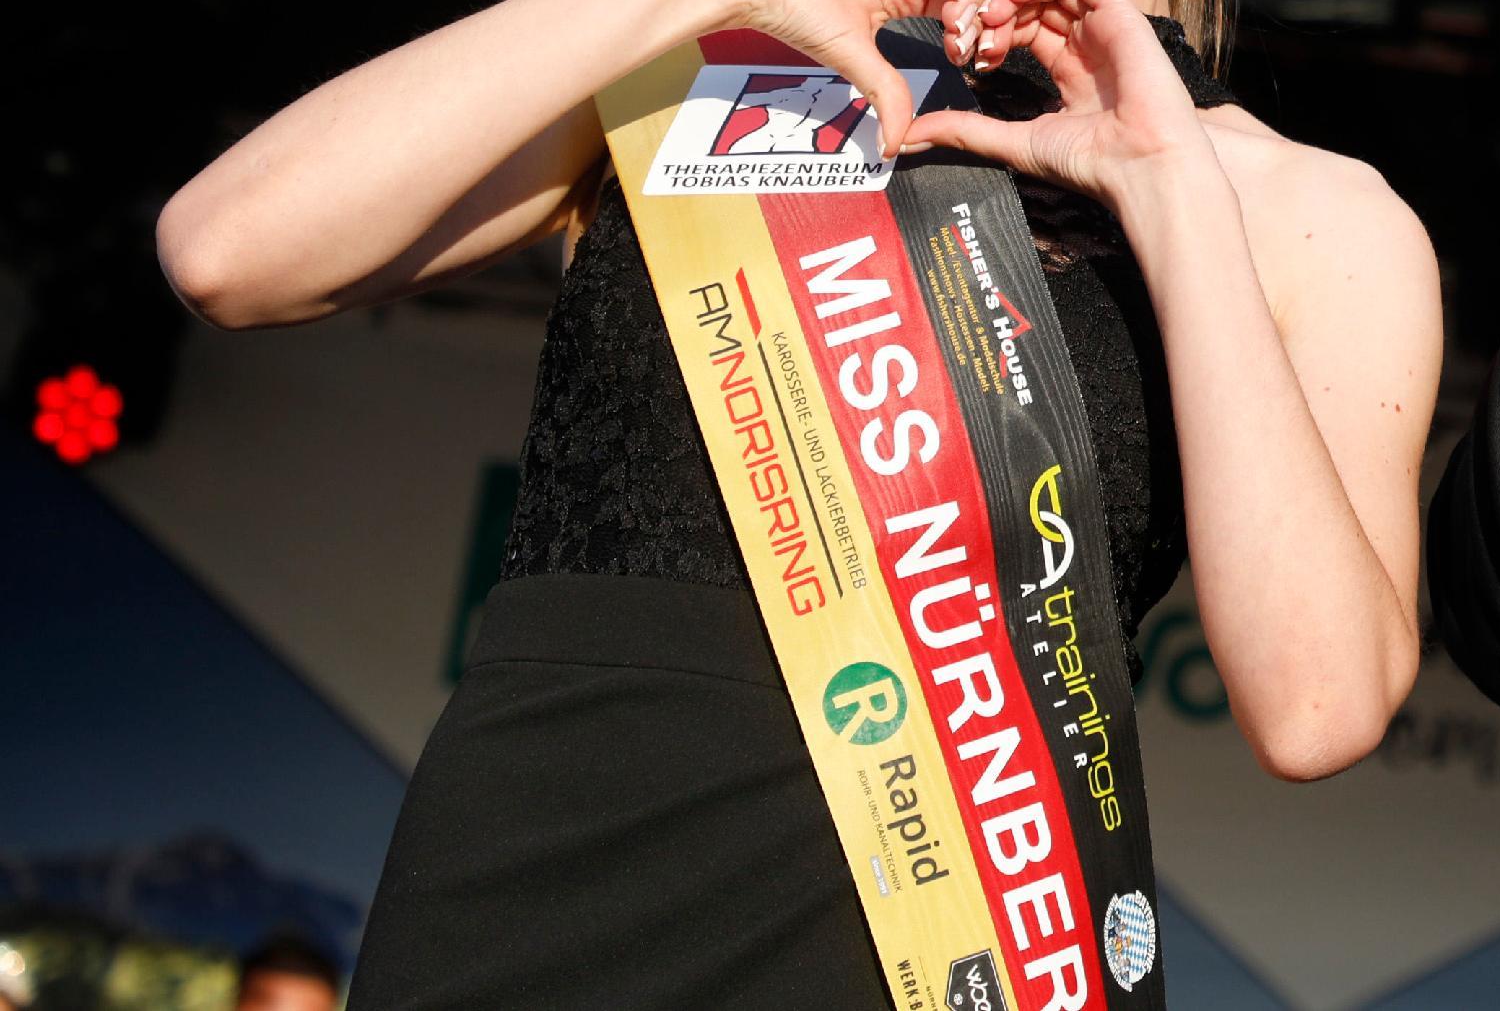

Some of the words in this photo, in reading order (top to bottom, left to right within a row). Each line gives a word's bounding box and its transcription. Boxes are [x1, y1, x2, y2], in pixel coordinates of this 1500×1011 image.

[663, 162, 883, 176] THERAPIEZENTRUM
[670, 176, 750, 188] TOBIAS
[758, 175, 866, 187] KNAUBER
[926, 268, 967, 367] www.fishershouse.de
[929, 236, 956, 300] Fashionshows
[972, 356, 990, 394] Models
[951, 202, 1000, 311] FISHER'S
[992, 315, 1034, 407] HOUSE
[979, 335, 1005, 395] Modelschule
[771, 331, 814, 427] KAROSSERIE-
[803, 428, 826, 463] UND
[815, 466, 867, 590] LACKIERBETRIEB
[798, 234, 940, 476] MISS
[885, 500, 1089, 1011] NÜRNBER
[1020, 583, 1090, 768] ATELIER
[1044, 586, 1123, 832] trainings
[868, 800, 881, 822] UND
[876, 822, 904, 893] KANALTECHNIK
[879, 754, 950, 886] Rapid
